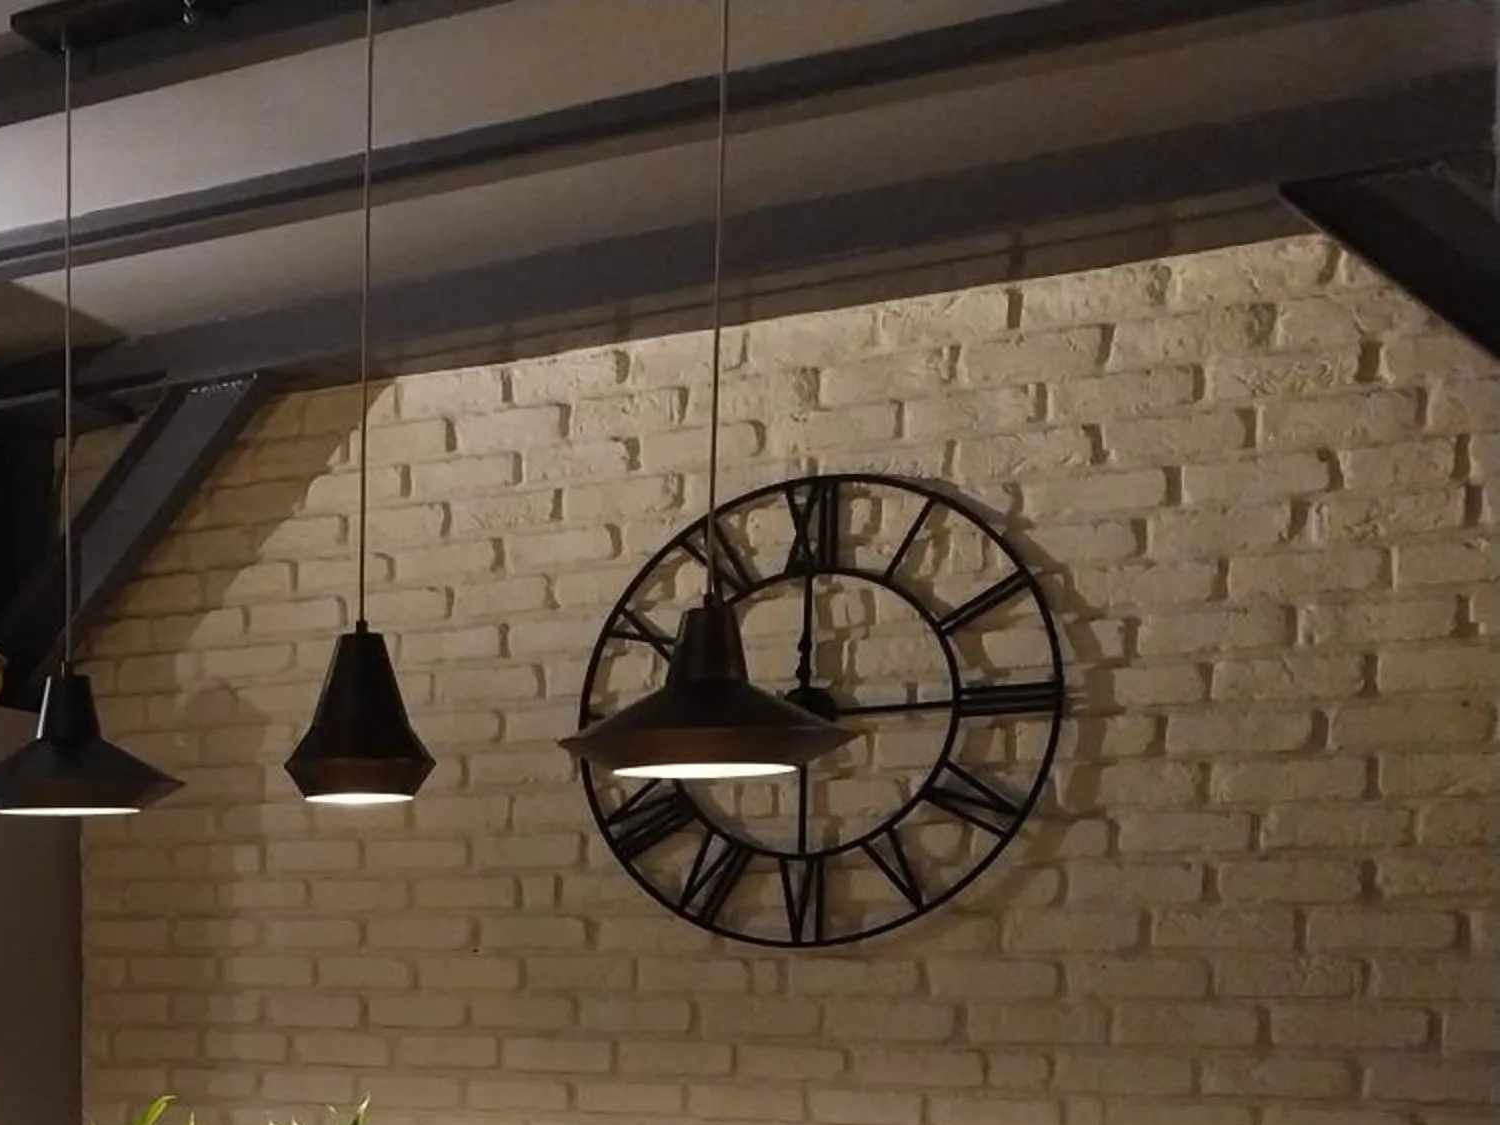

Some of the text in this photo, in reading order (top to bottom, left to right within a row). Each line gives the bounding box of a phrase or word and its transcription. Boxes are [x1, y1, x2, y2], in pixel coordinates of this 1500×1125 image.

[784, 479, 840, 574] XII
[938, 567, 1035, 635] II
[956, 680, 1063, 718] III
[778, 855, 826, 944] VI
